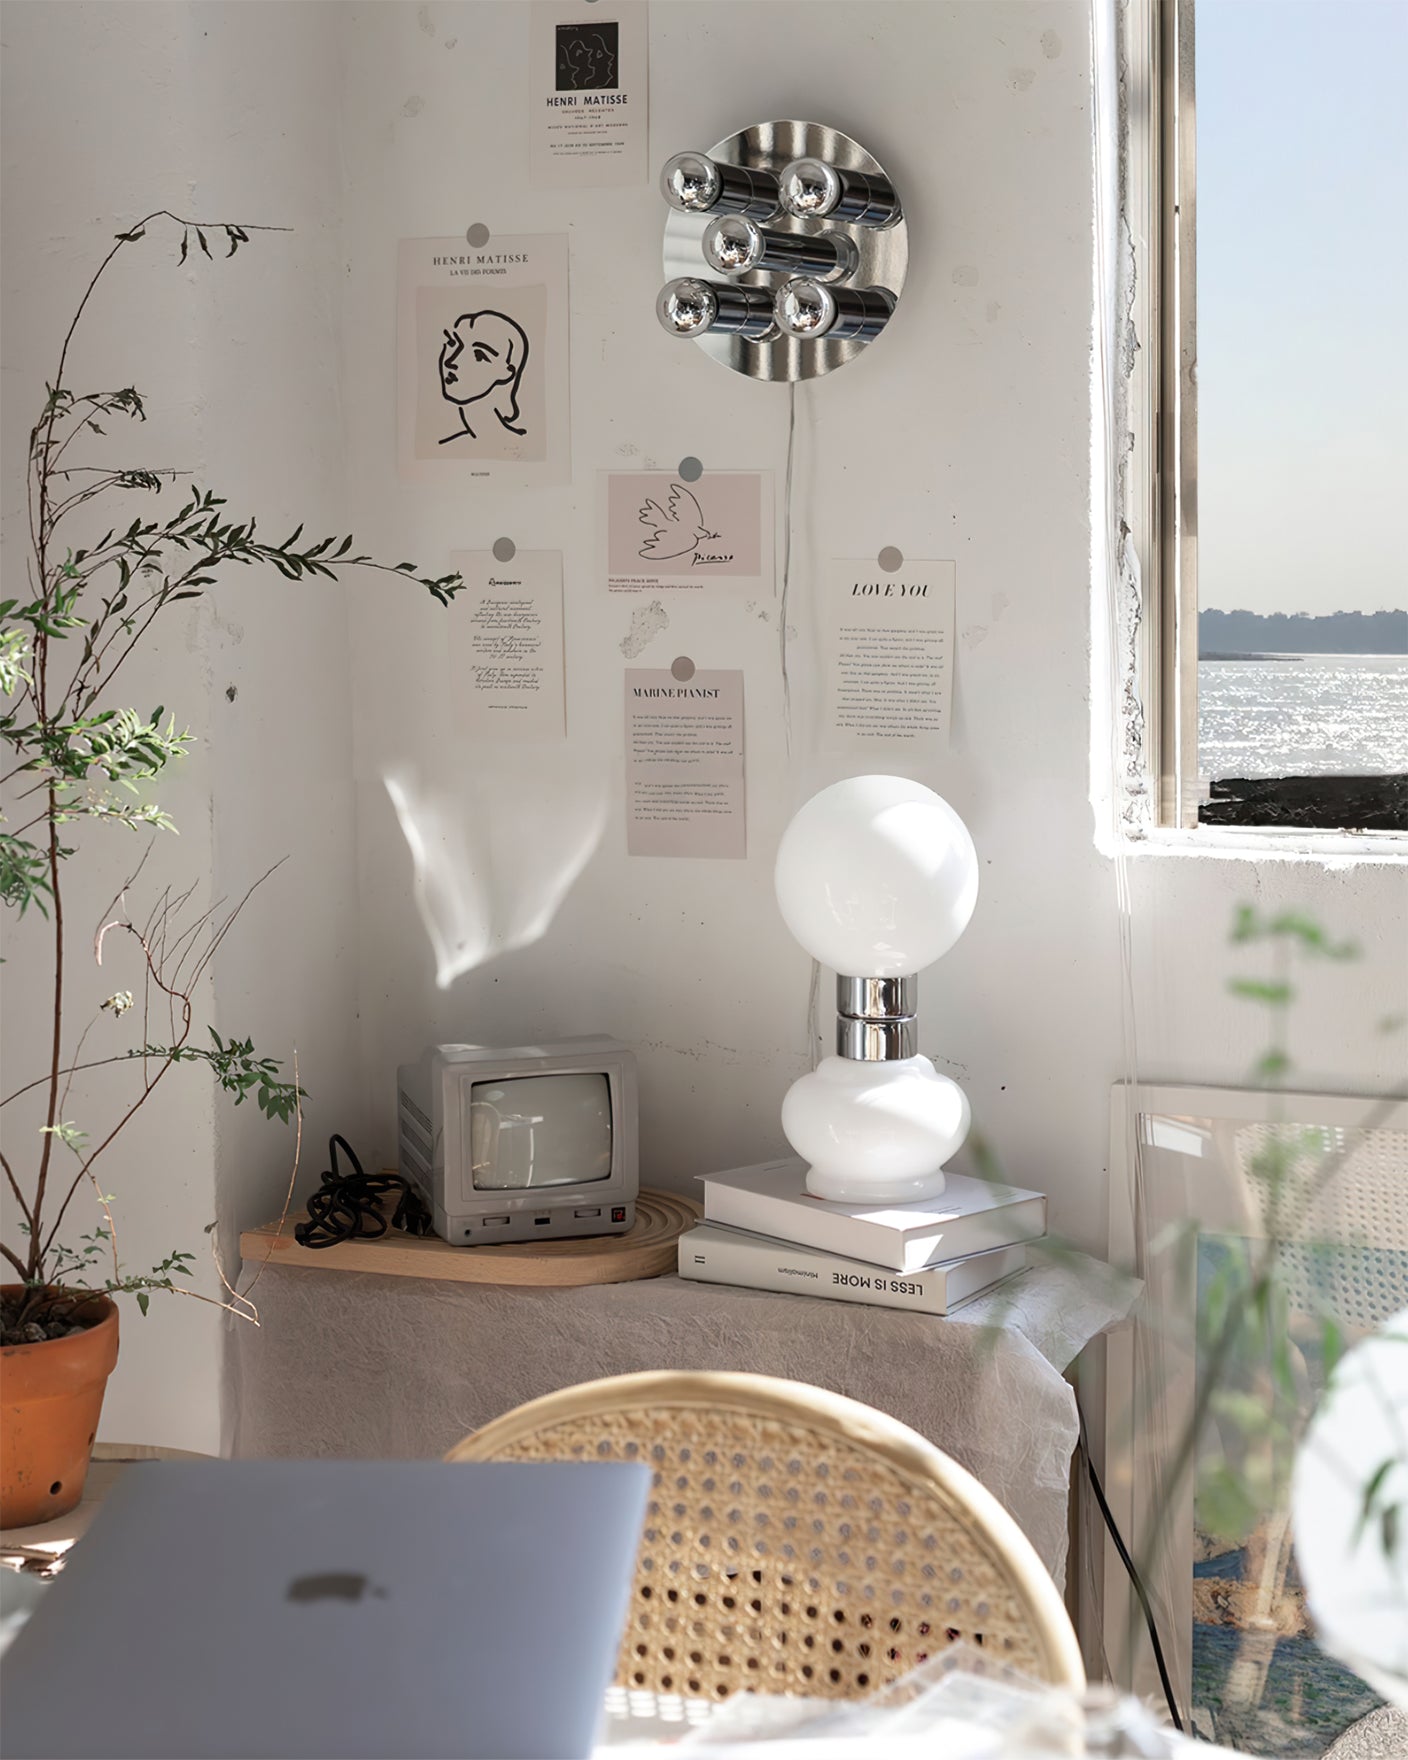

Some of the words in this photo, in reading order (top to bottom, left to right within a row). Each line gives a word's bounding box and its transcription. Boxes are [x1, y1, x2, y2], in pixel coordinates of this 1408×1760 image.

[546, 96, 577, 107] HENRI
[583, 94, 628, 105] MATISSE
[433, 256, 470, 265] HENRI
[476, 254, 529, 264] MATISSE
[852, 583, 895, 597] LOVE
[900, 584, 929, 597] YOU
[633, 688, 676, 698] MARINE
[677, 688, 720, 698] PIANIST
[777, 1267, 819, 1279] Minimalism
[832, 1272, 871, 1288] MORE
[874, 1279, 887, 1291] IS
[890, 1280, 924, 1296] LESS
